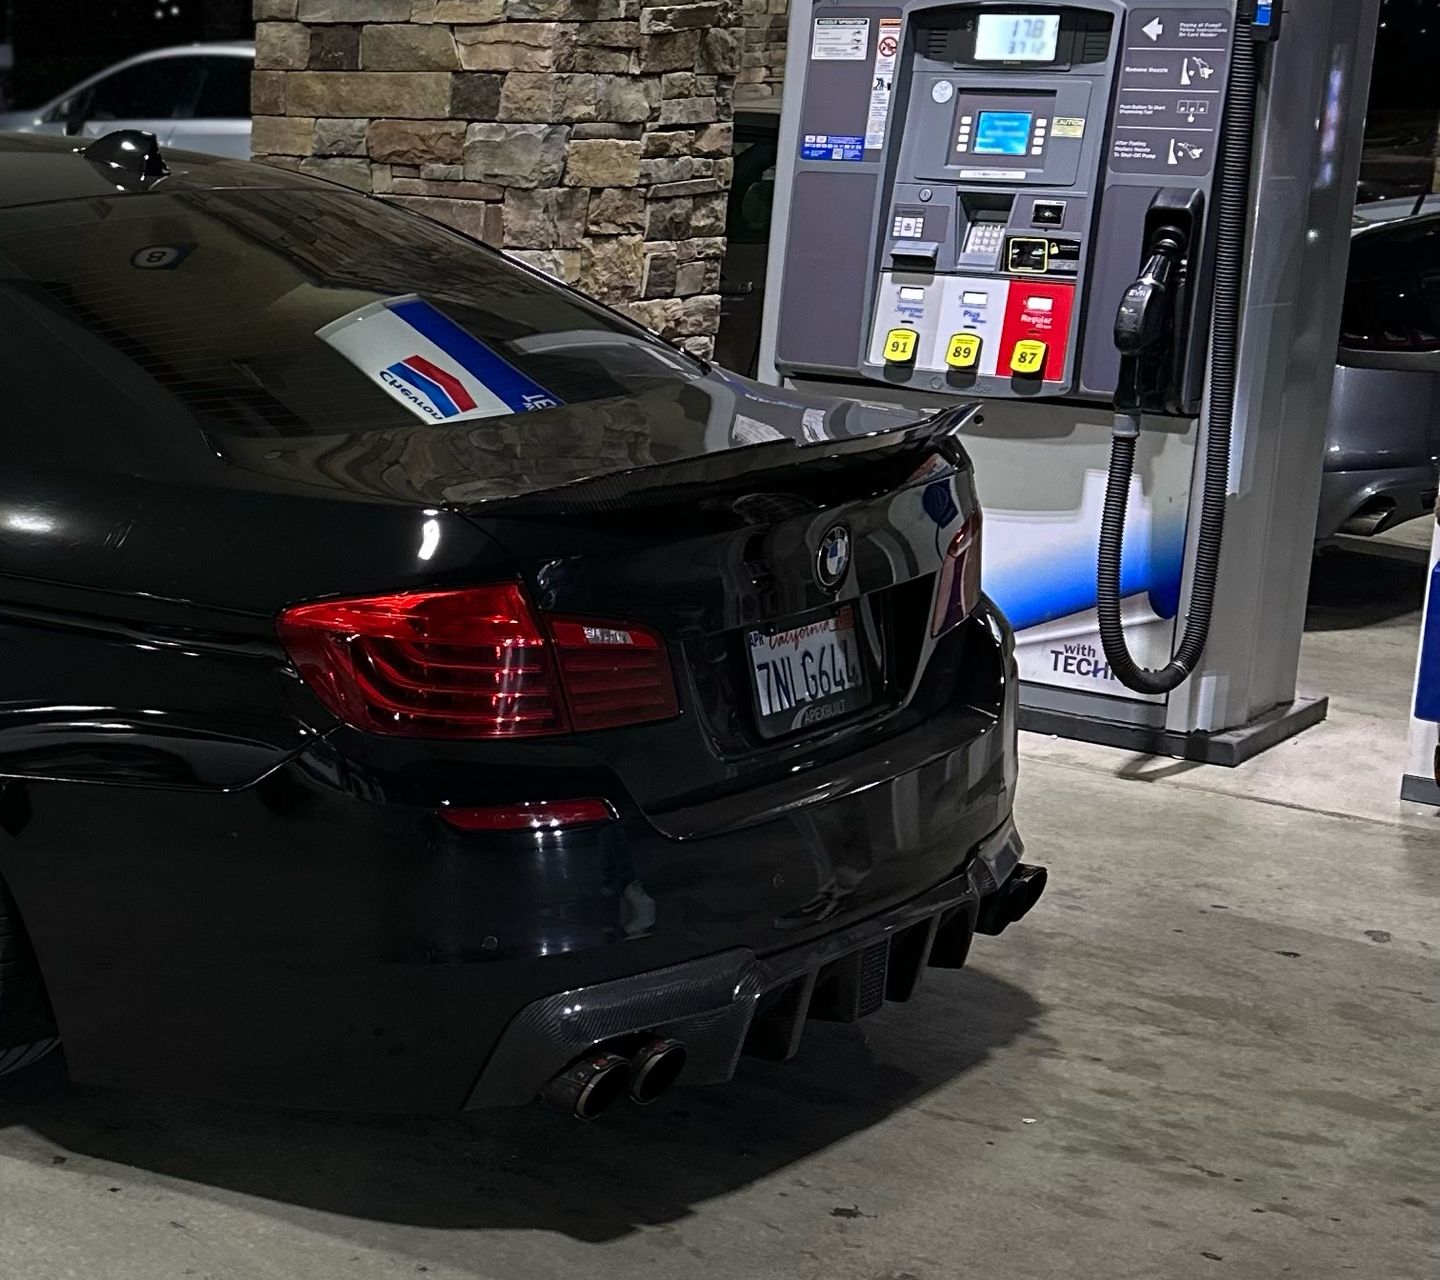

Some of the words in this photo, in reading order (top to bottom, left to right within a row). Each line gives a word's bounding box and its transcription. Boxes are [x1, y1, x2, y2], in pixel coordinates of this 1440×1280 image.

[1020, 314, 1053, 325] Regular
[890, 341, 908, 353] 91
[953, 346, 972, 359] 89
[1018, 352, 1039, 365] 87
[1063, 643, 1096, 658] with
